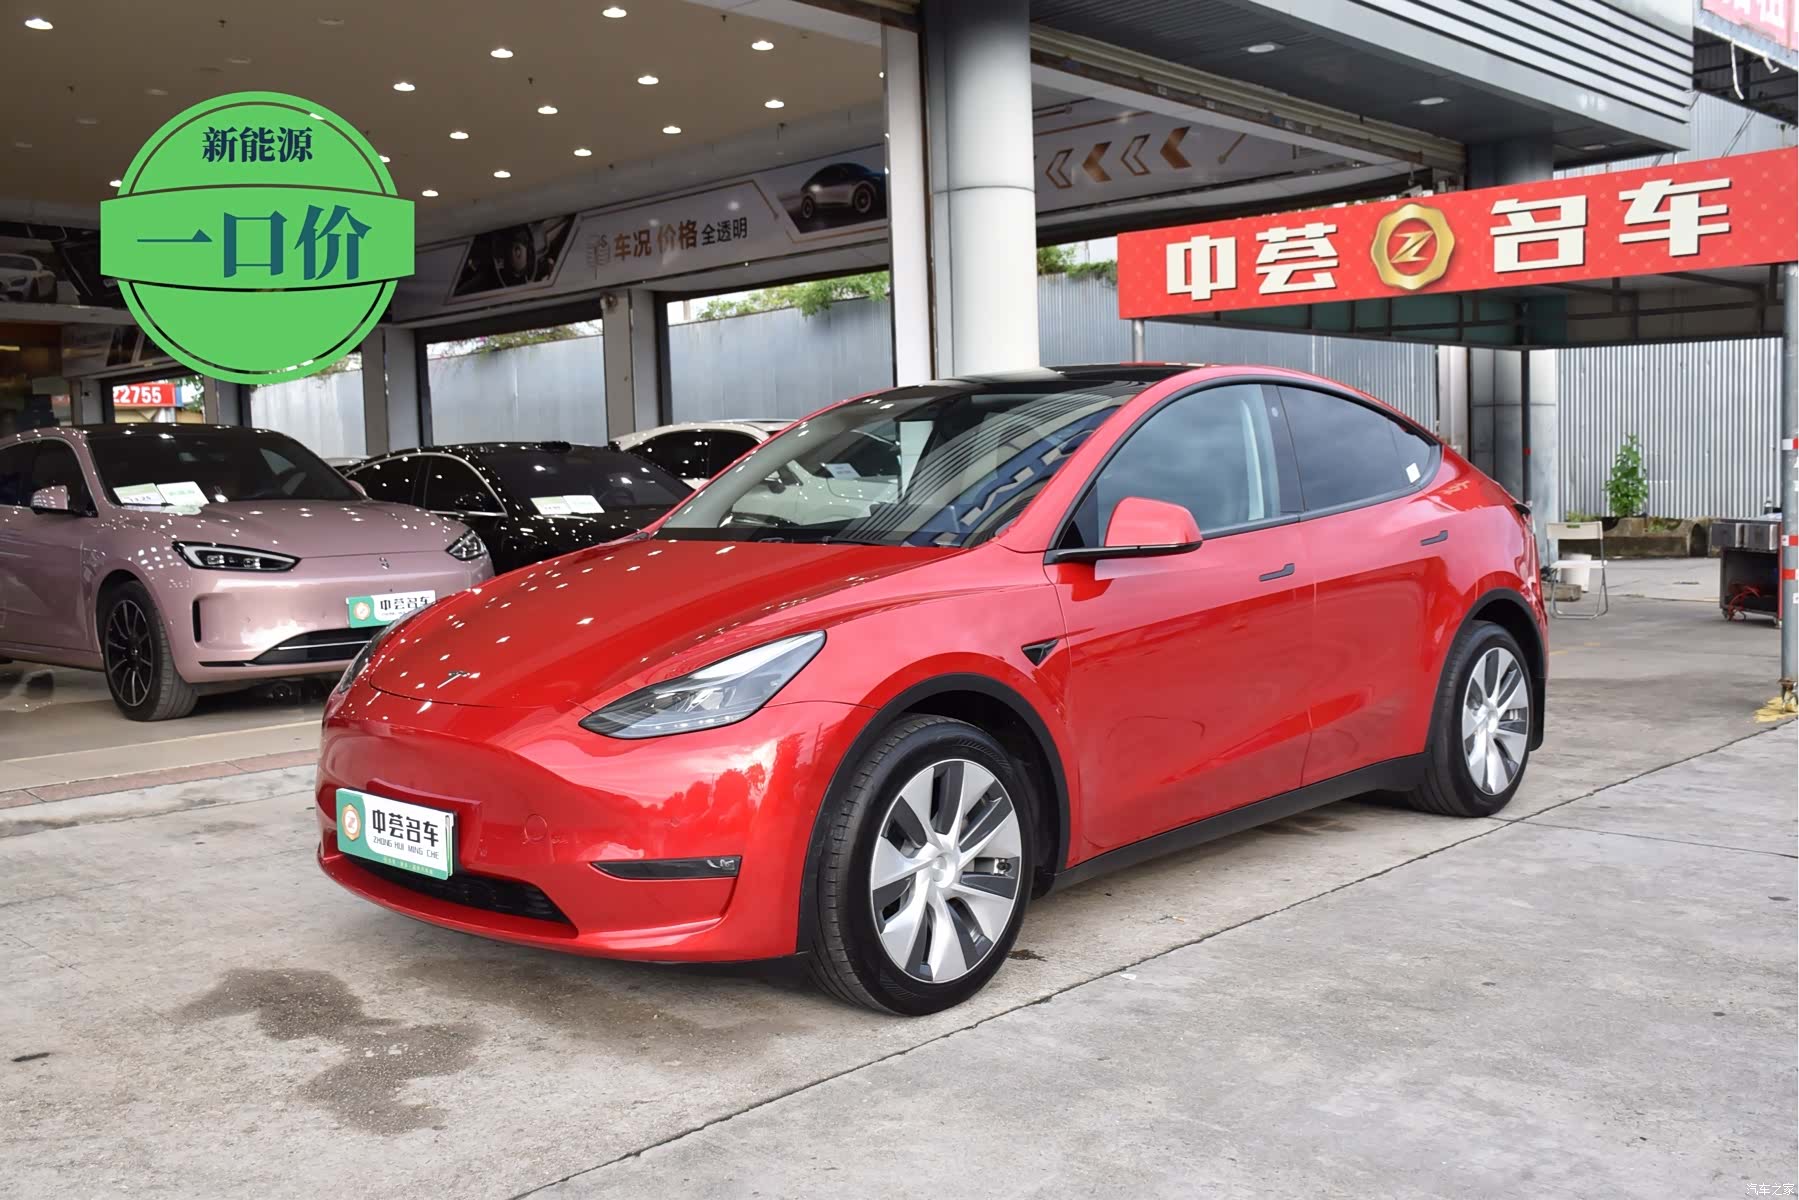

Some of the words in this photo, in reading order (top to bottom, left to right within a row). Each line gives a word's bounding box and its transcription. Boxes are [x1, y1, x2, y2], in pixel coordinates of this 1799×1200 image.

[614, 229, 652, 261] 车况
[656, 219, 698, 254] 价格
[701, 216, 748, 247] 全透明
[1166, 222, 1339, 300] 中荟
[1490, 178, 1731, 273] 名车
[372, 809, 439, 847] 中荟名车
[373, 836, 393, 848] ZHONG
[394, 842, 405, 851] HUI
[407, 846, 424, 856] MING
[426, 850, 440, 860] CHE
